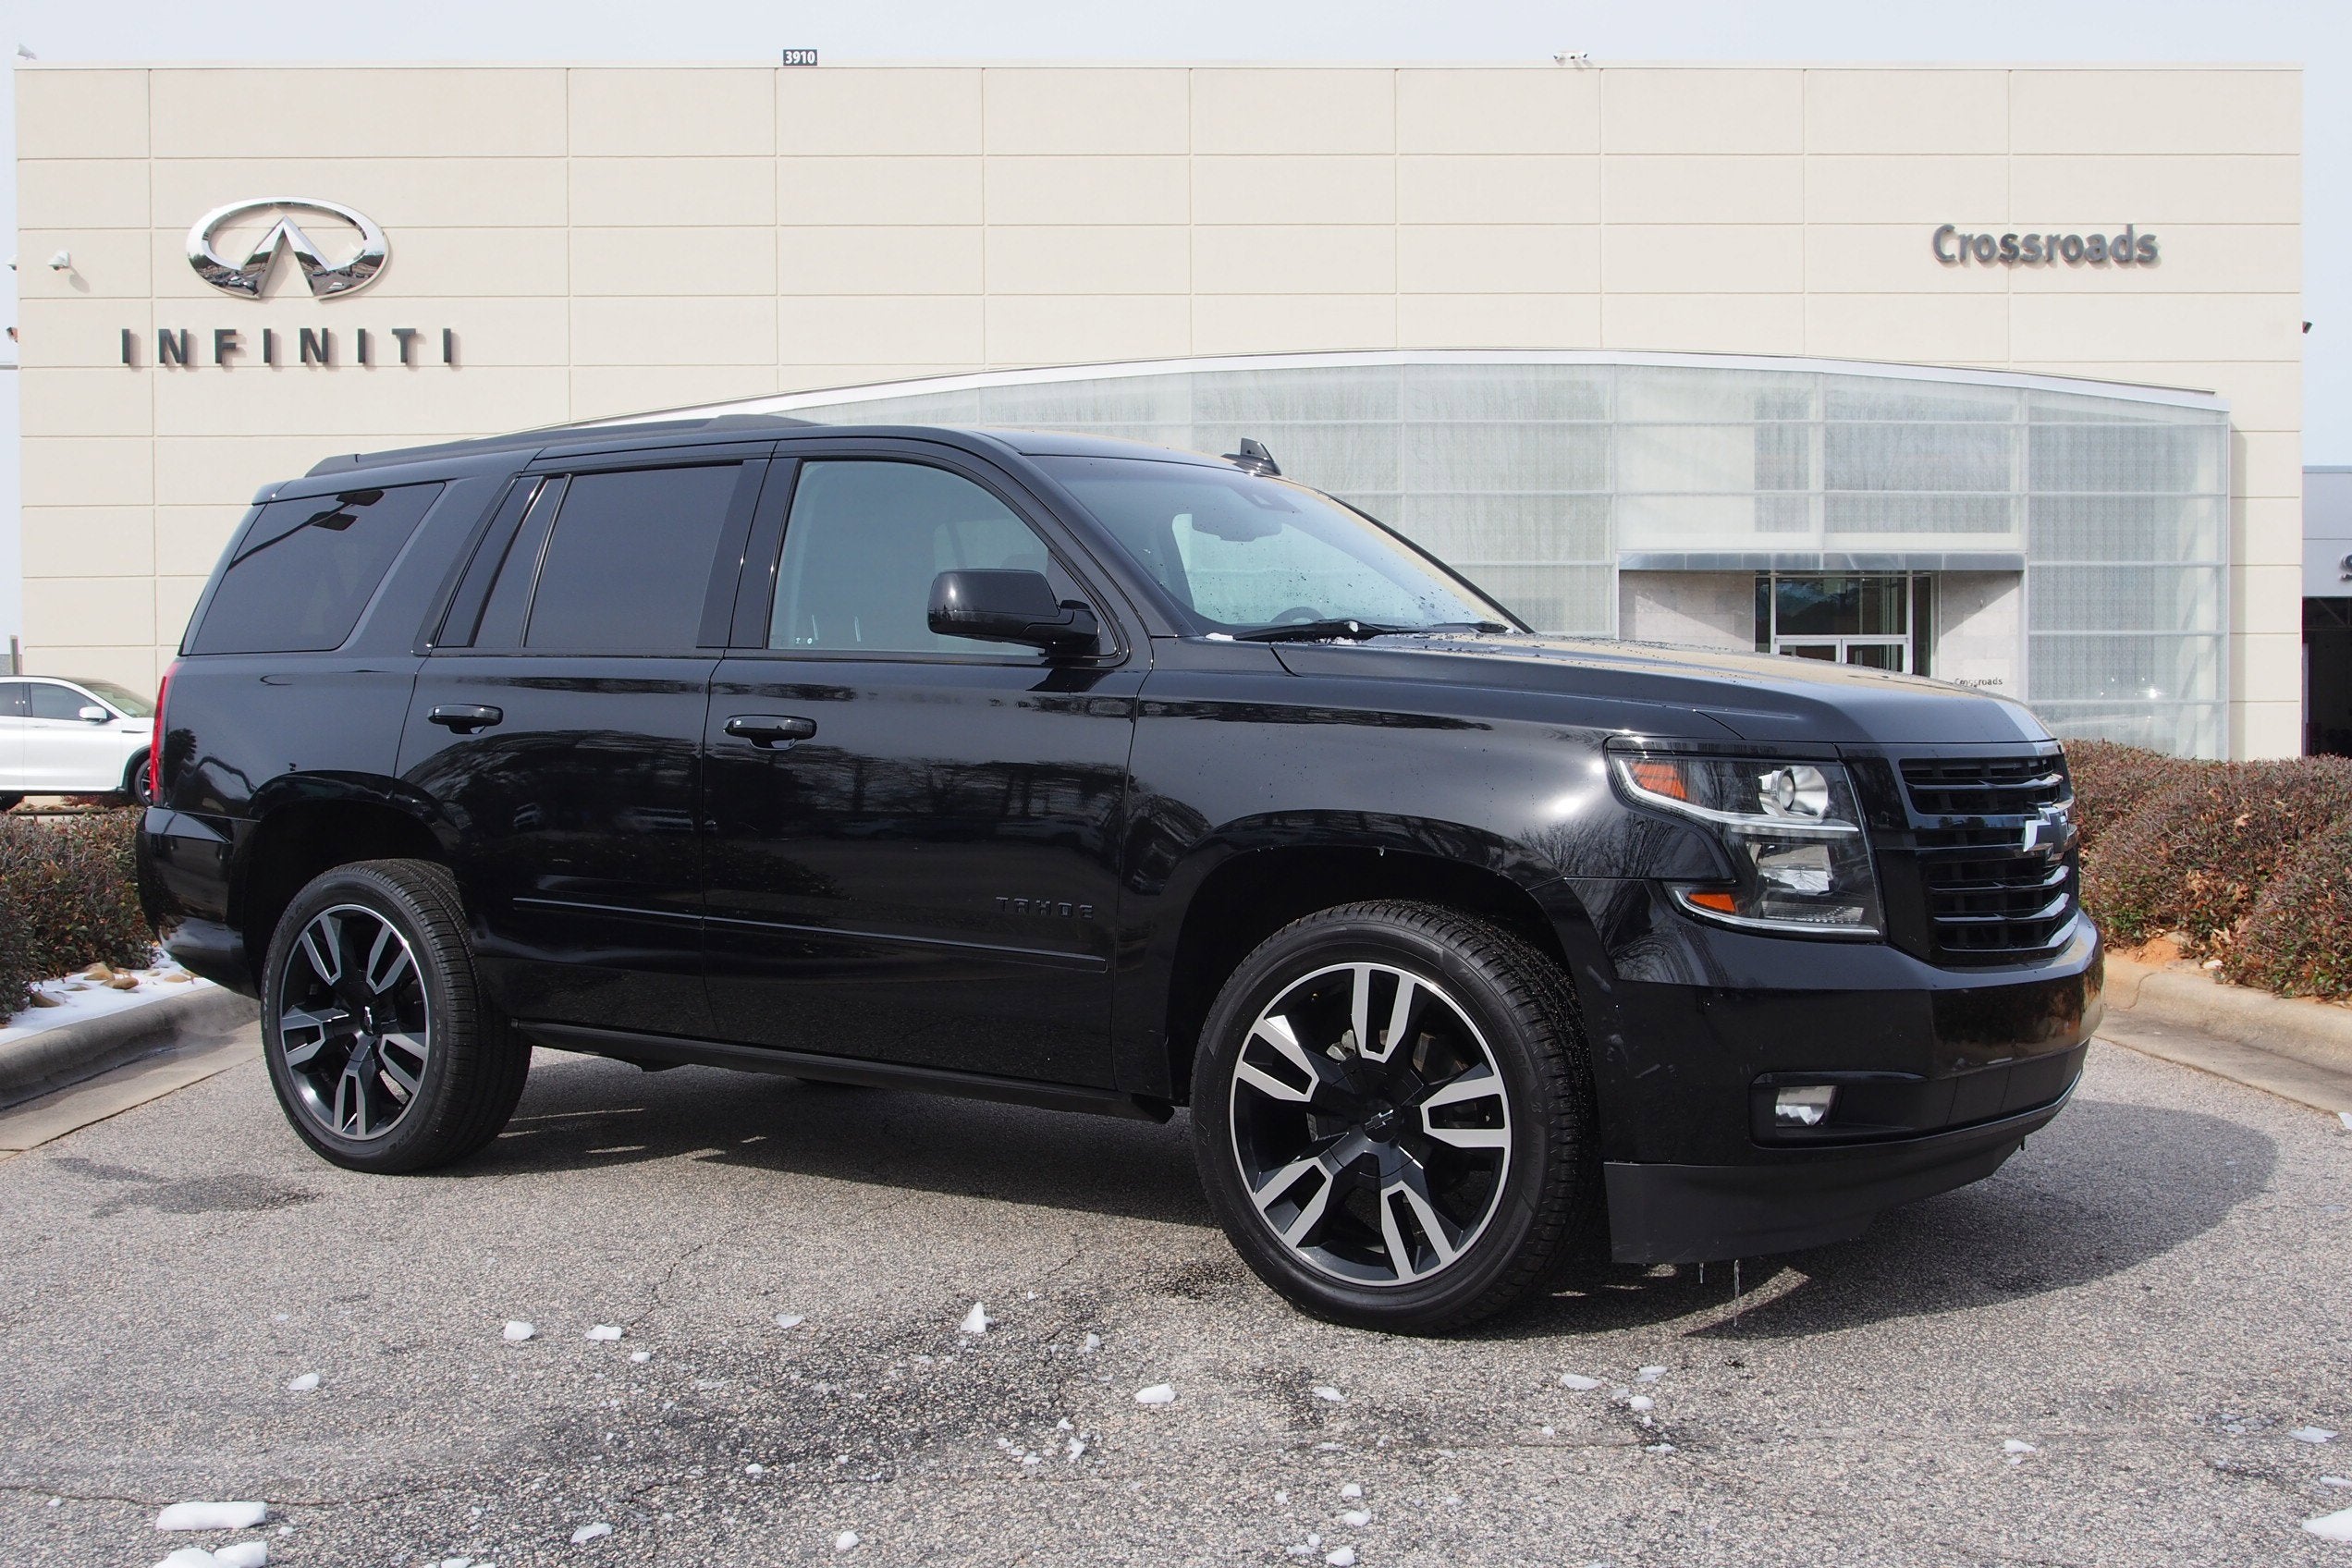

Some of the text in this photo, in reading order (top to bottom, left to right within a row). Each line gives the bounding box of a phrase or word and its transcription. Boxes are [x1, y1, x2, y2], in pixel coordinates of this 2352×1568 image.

[785, 50, 815, 64] 3910
[1932, 224, 2159, 263] Crossroads
[121, 327, 453, 364] INFINITI
[996, 896, 1094, 919] TAHOE
